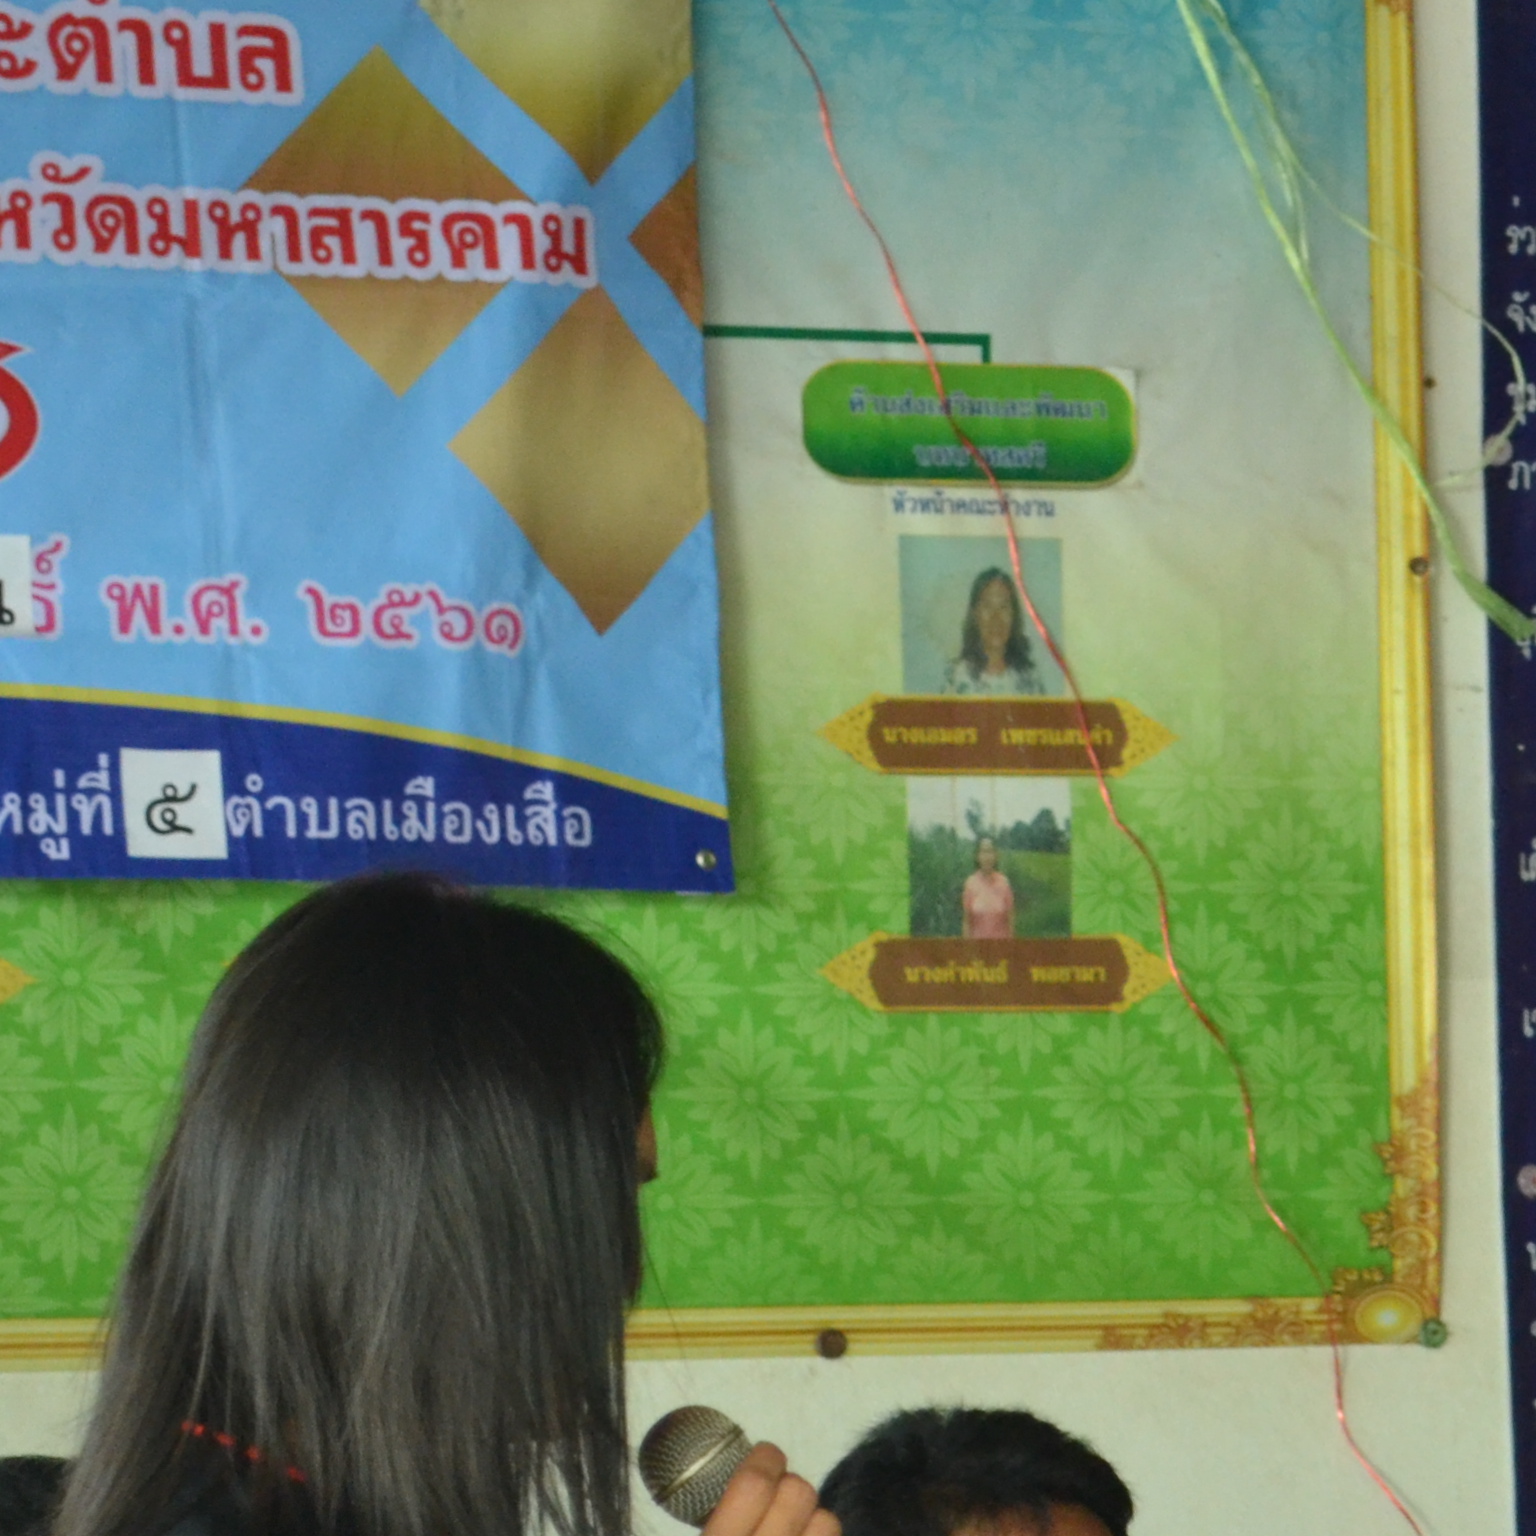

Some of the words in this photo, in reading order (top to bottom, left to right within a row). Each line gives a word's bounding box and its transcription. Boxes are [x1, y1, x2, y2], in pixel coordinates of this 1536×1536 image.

[107, 580, 263, 636] พ.ศ.
[145, 782, 198, 835] ๕
[226, 773, 592, 846] ตำบลเมืองเสือ
